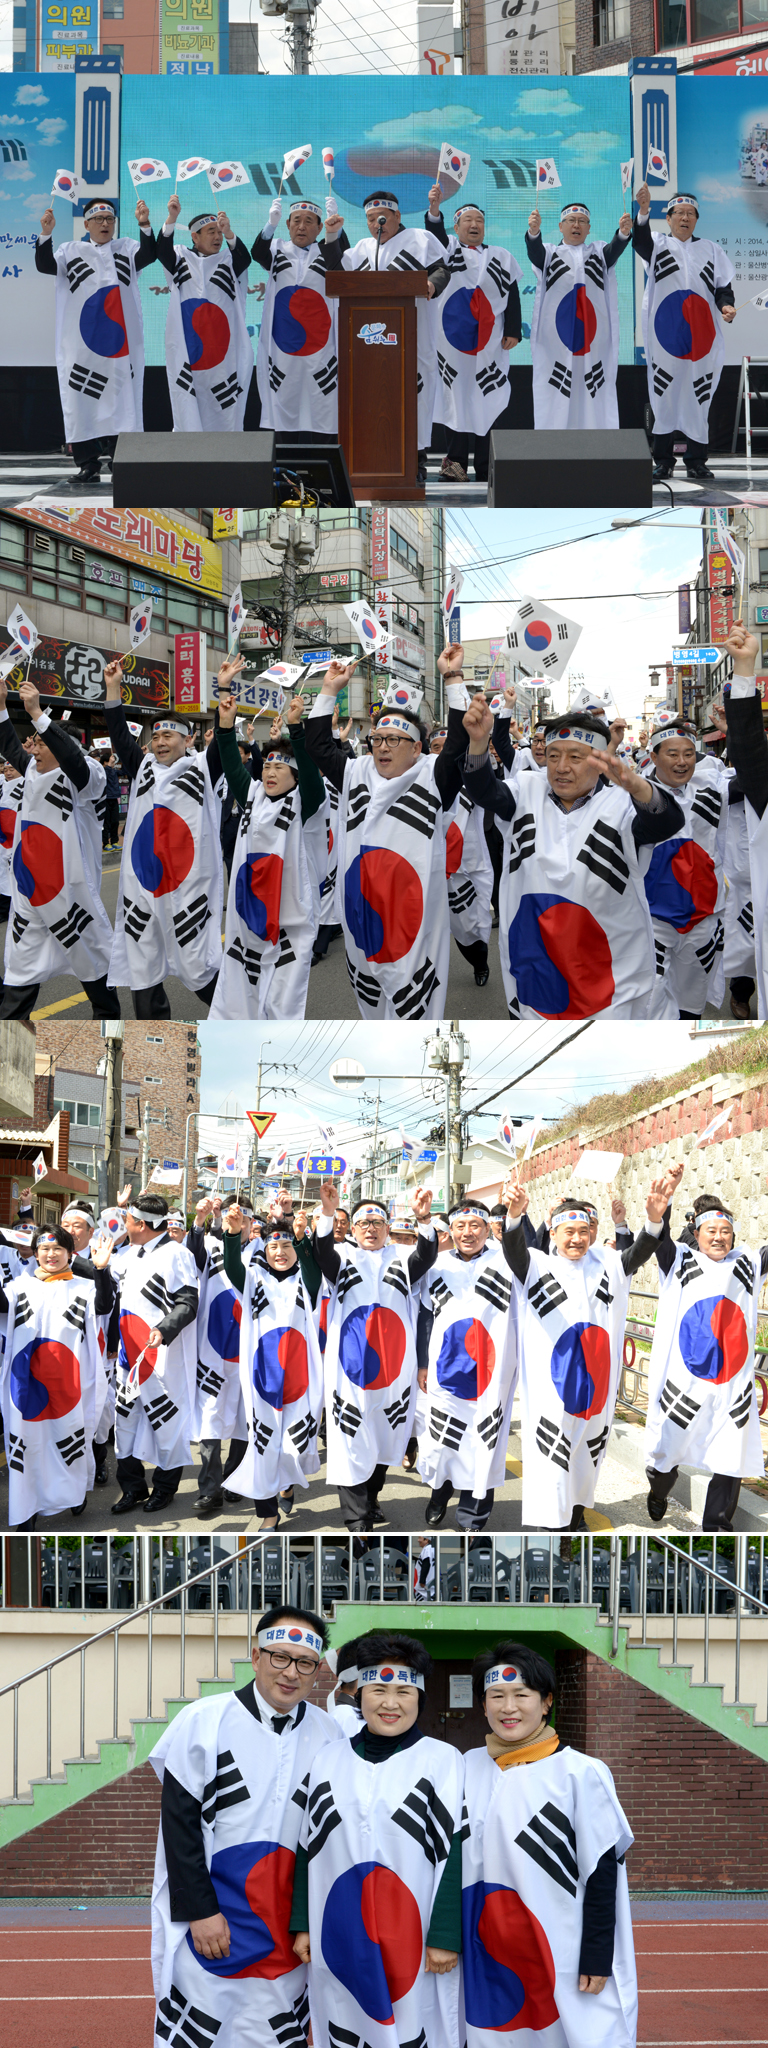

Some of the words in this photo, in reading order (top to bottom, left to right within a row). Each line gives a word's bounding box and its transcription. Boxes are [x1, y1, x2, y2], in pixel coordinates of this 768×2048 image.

[46, 5, 91, 26] 의원
[165, 0, 213, 20] 의원
[56, 31, 83, 39] 진료과목
[165, 34, 215, 51] 비뇨기과
[90, 562, 124, 590] 호프
[132, 577, 163, 604] 맥주
[321, 573, 349, 587] 탁구장
[179, 635, 196, 702] 고려홍삼
[392, 718, 410, 731] 독립
[573, 730, 594, 744] 독립
[660, 730, 675, 739] 대한
[275, 755, 291, 764] 독립
[266, 1628, 286, 1640] 대한
[305, 1633, 321, 1651] 독립
[362, 1669, 378, 1682] 대한
[397, 1670, 417, 1684] 독립
[485, 1669, 500, 1684] 대한
